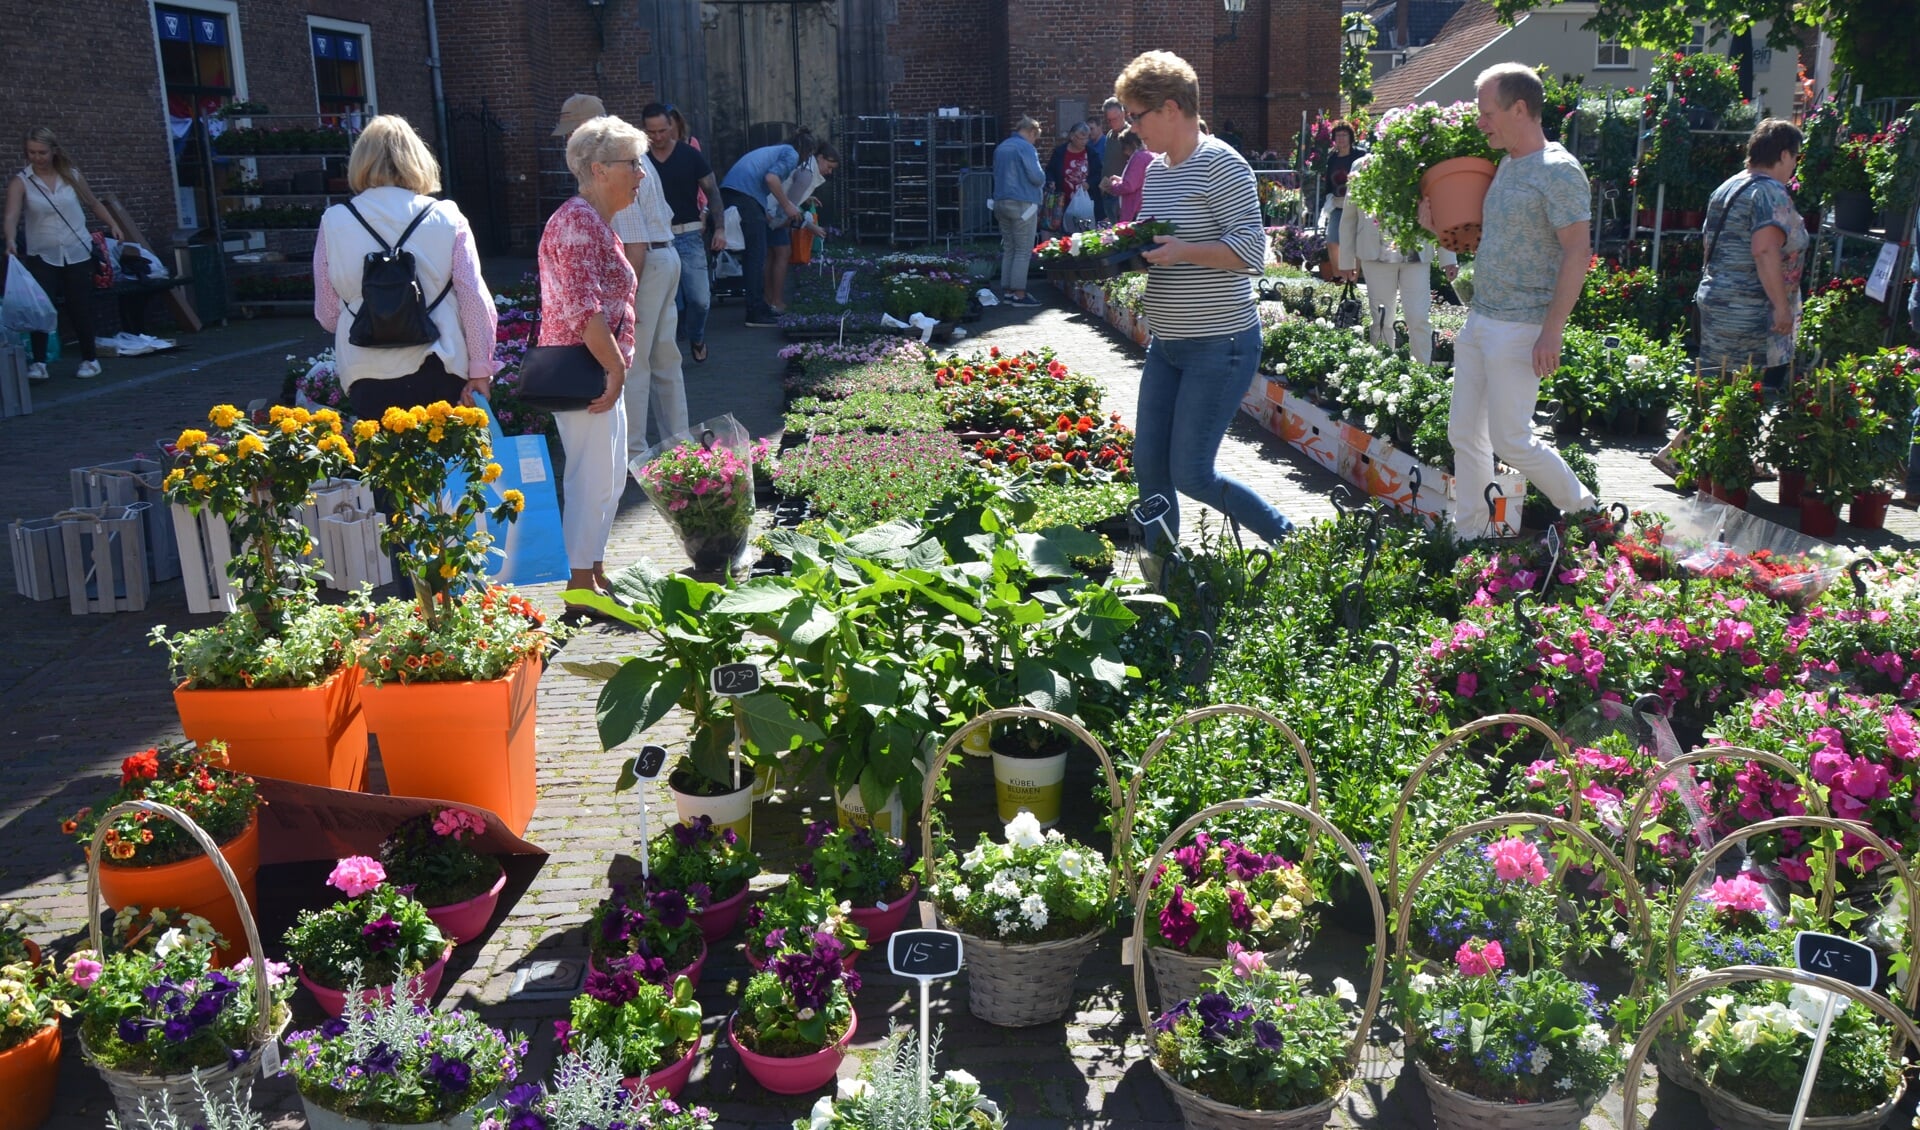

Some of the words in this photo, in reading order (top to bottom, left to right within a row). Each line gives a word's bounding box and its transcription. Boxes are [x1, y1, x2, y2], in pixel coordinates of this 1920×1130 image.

[1009, 778, 1036, 787] KÜBEL
[1007, 785, 1041, 795] BLUMEN
[845, 803, 866, 814] KÜBE
